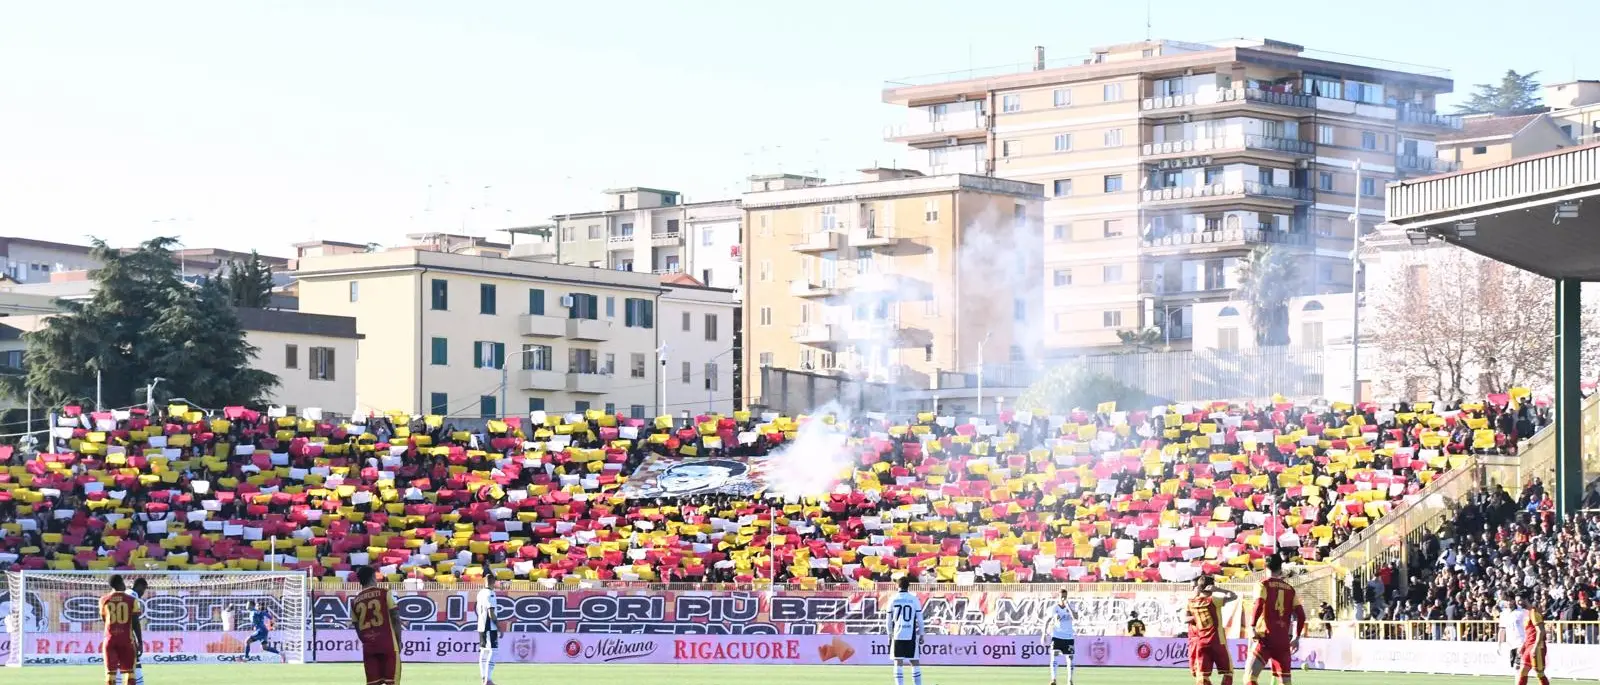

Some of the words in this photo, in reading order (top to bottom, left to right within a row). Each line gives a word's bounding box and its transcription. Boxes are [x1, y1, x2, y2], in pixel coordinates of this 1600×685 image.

[446, 595, 465, 620] I
[676, 591, 760, 621] PIÙ
[894, 604, 913, 622] 70
[1274, 589, 1285, 617] 4
[355, 599, 384, 631] 23
[153, 654, 198, 663] GoldBet
[584, 638, 658, 661] Molisana
[674, 639, 800, 659] RIGACUORE
[983, 642, 1016, 659] ogni
